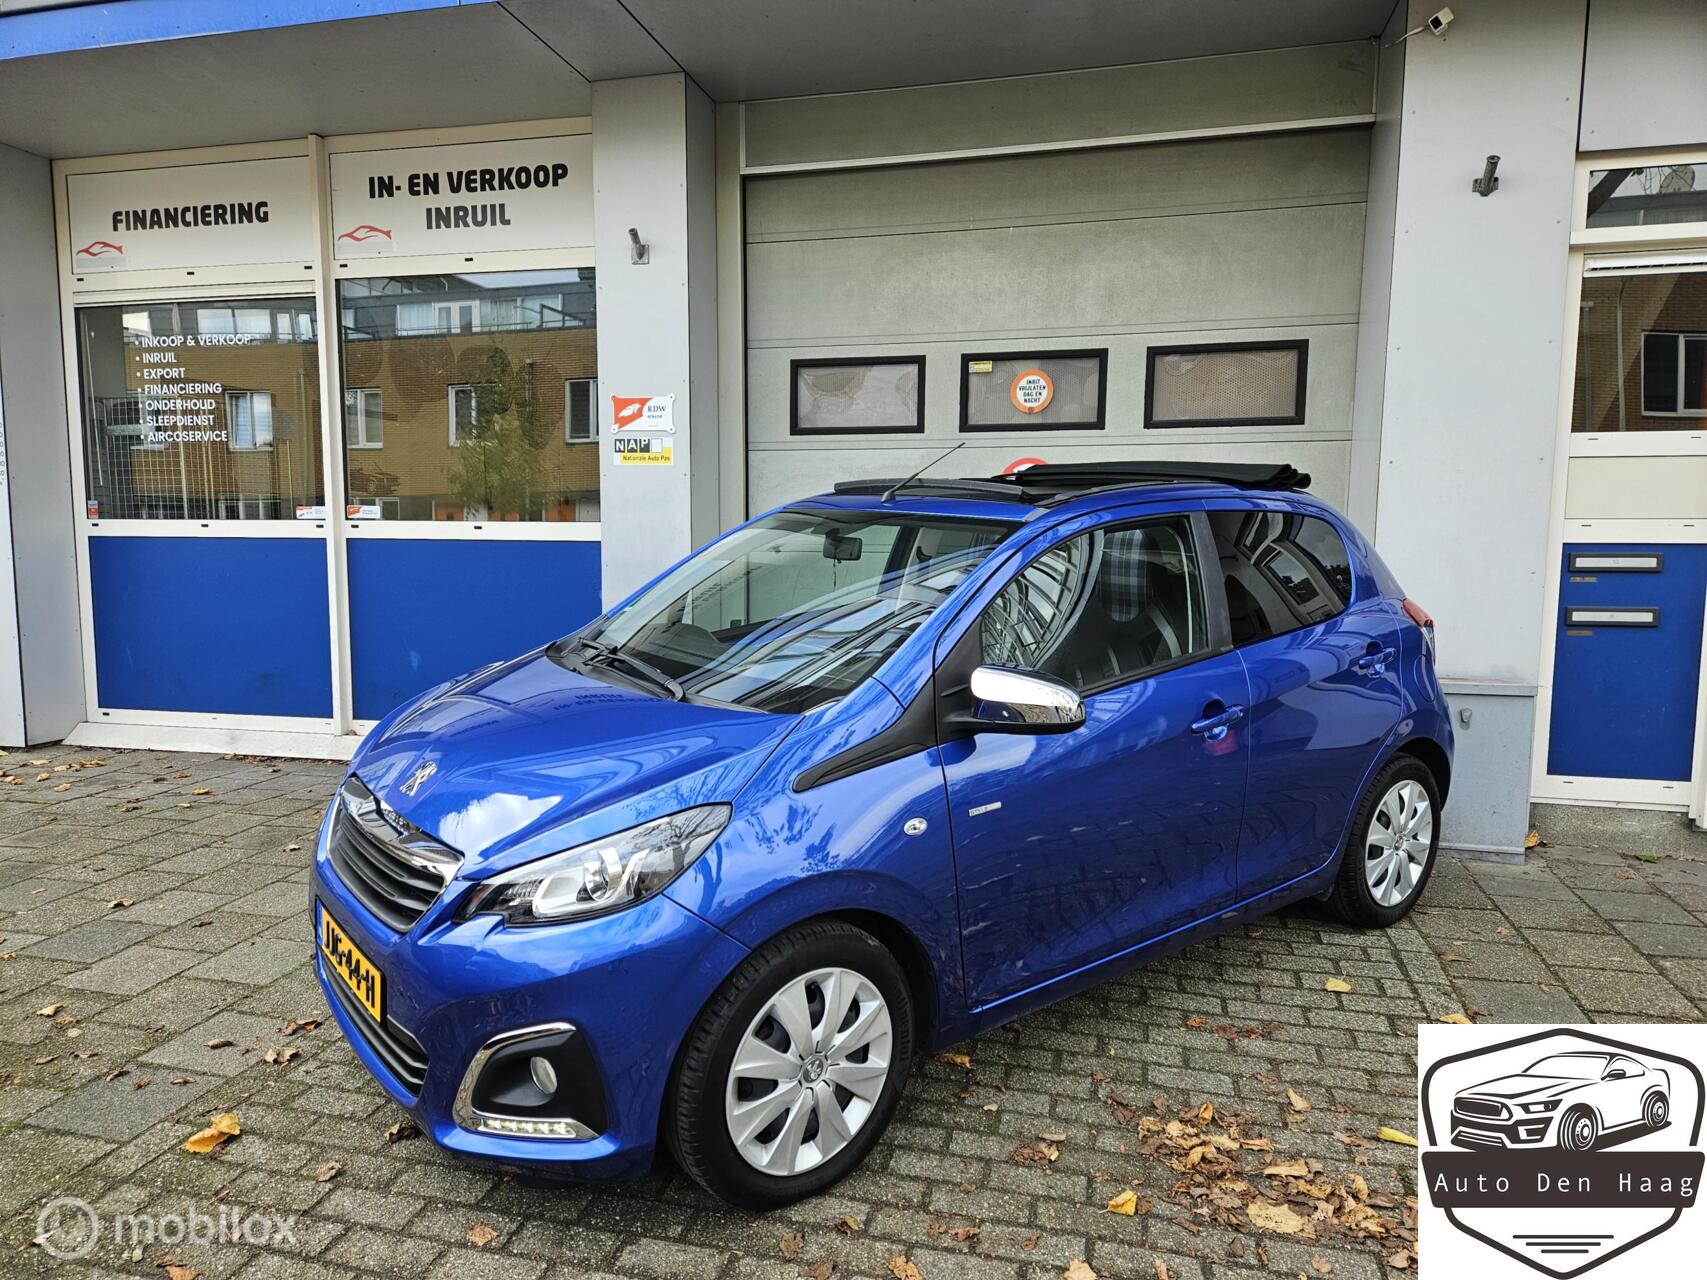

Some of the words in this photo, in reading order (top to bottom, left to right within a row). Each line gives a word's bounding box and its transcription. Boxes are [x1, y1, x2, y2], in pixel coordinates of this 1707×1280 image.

[368, 175, 401, 199] IN-
[407, 172, 440, 197] EN
[446, 163, 569, 194] VERKOOP
[112, 201, 269, 232] FINANCIERING
[426, 203, 511, 230] INRUIL
[142, 335, 184, 348] INKOOP
[186, 335, 196, 346] &
[198, 334, 251, 346] VERKOOP
[142, 352, 177, 363] INRUIL
[143, 368, 186, 379] EXPORT
[144, 383, 222, 395] FINANCIERING
[145, 399, 216, 411] ONDERHOUD
[647, 405, 667, 413] RDW
[146, 415, 215, 427] SLEEPDIENST
[147, 430, 228, 442] AIRCOSERVICE
[615, 439, 649, 452] NAP
